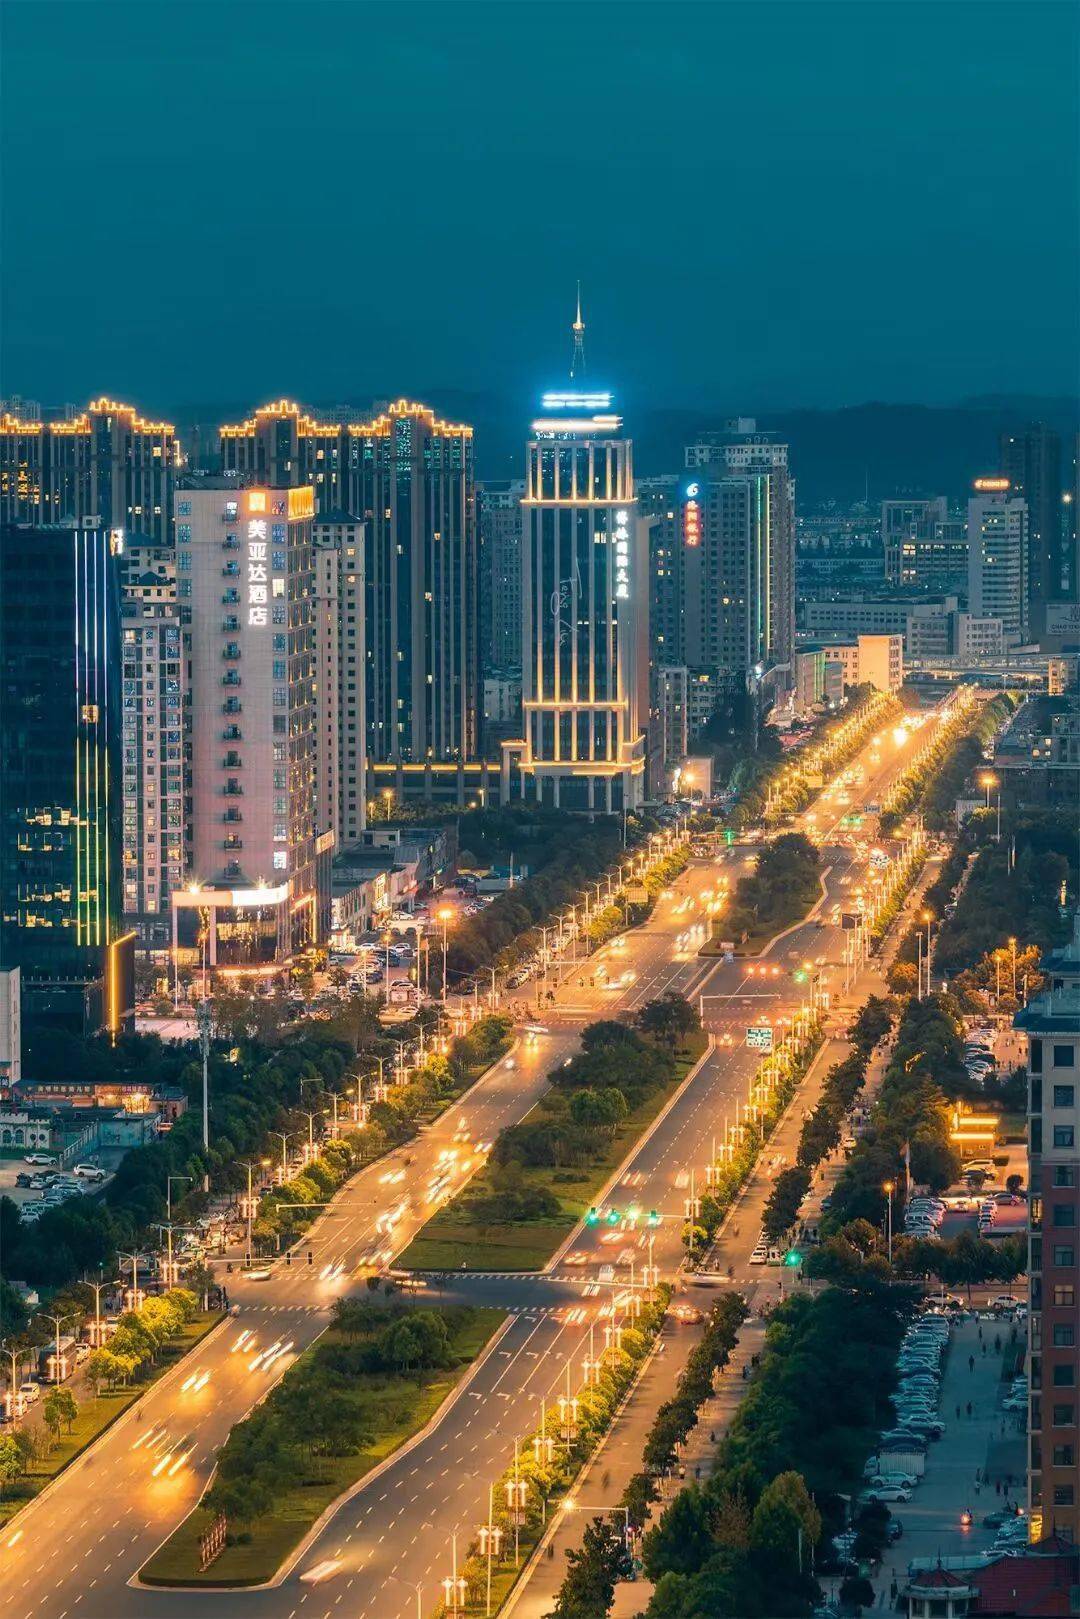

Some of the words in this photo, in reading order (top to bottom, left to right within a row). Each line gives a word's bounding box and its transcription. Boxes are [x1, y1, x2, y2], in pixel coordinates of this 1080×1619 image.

[248, 519, 267, 625] 美亚达酒店
